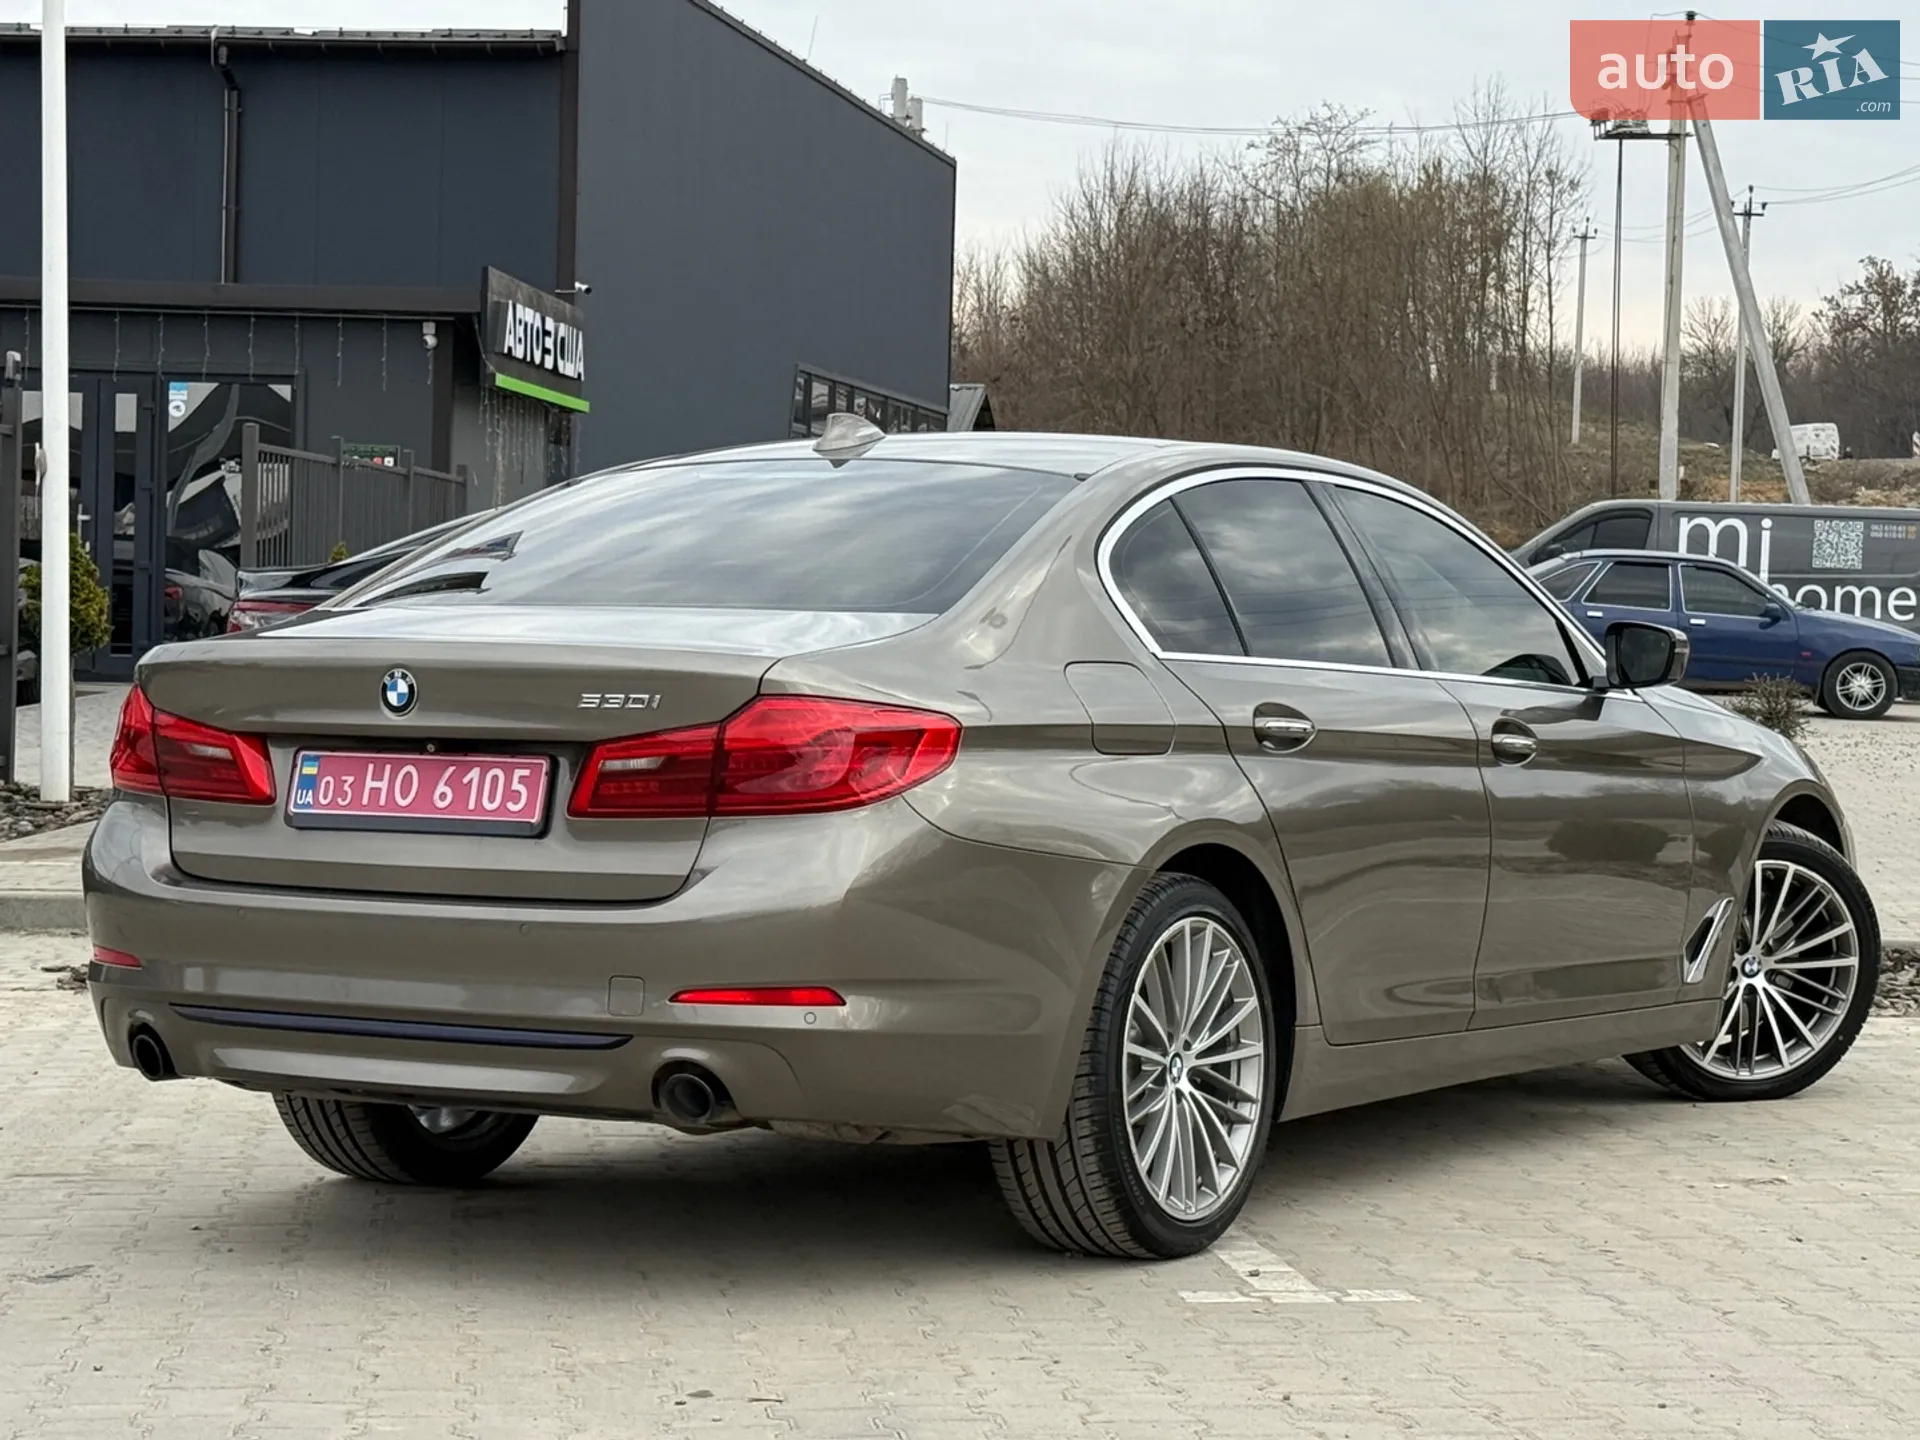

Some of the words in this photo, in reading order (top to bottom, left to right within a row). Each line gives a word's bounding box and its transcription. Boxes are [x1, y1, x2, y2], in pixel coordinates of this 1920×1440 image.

[503, 299, 542, 365] АВТО
[557, 322, 584, 382] США
[577, 693, 661, 709] 530i
[296, 789, 314, 805] UA
[318, 775, 355, 807] 03
[432, 765, 531, 812] 6105
